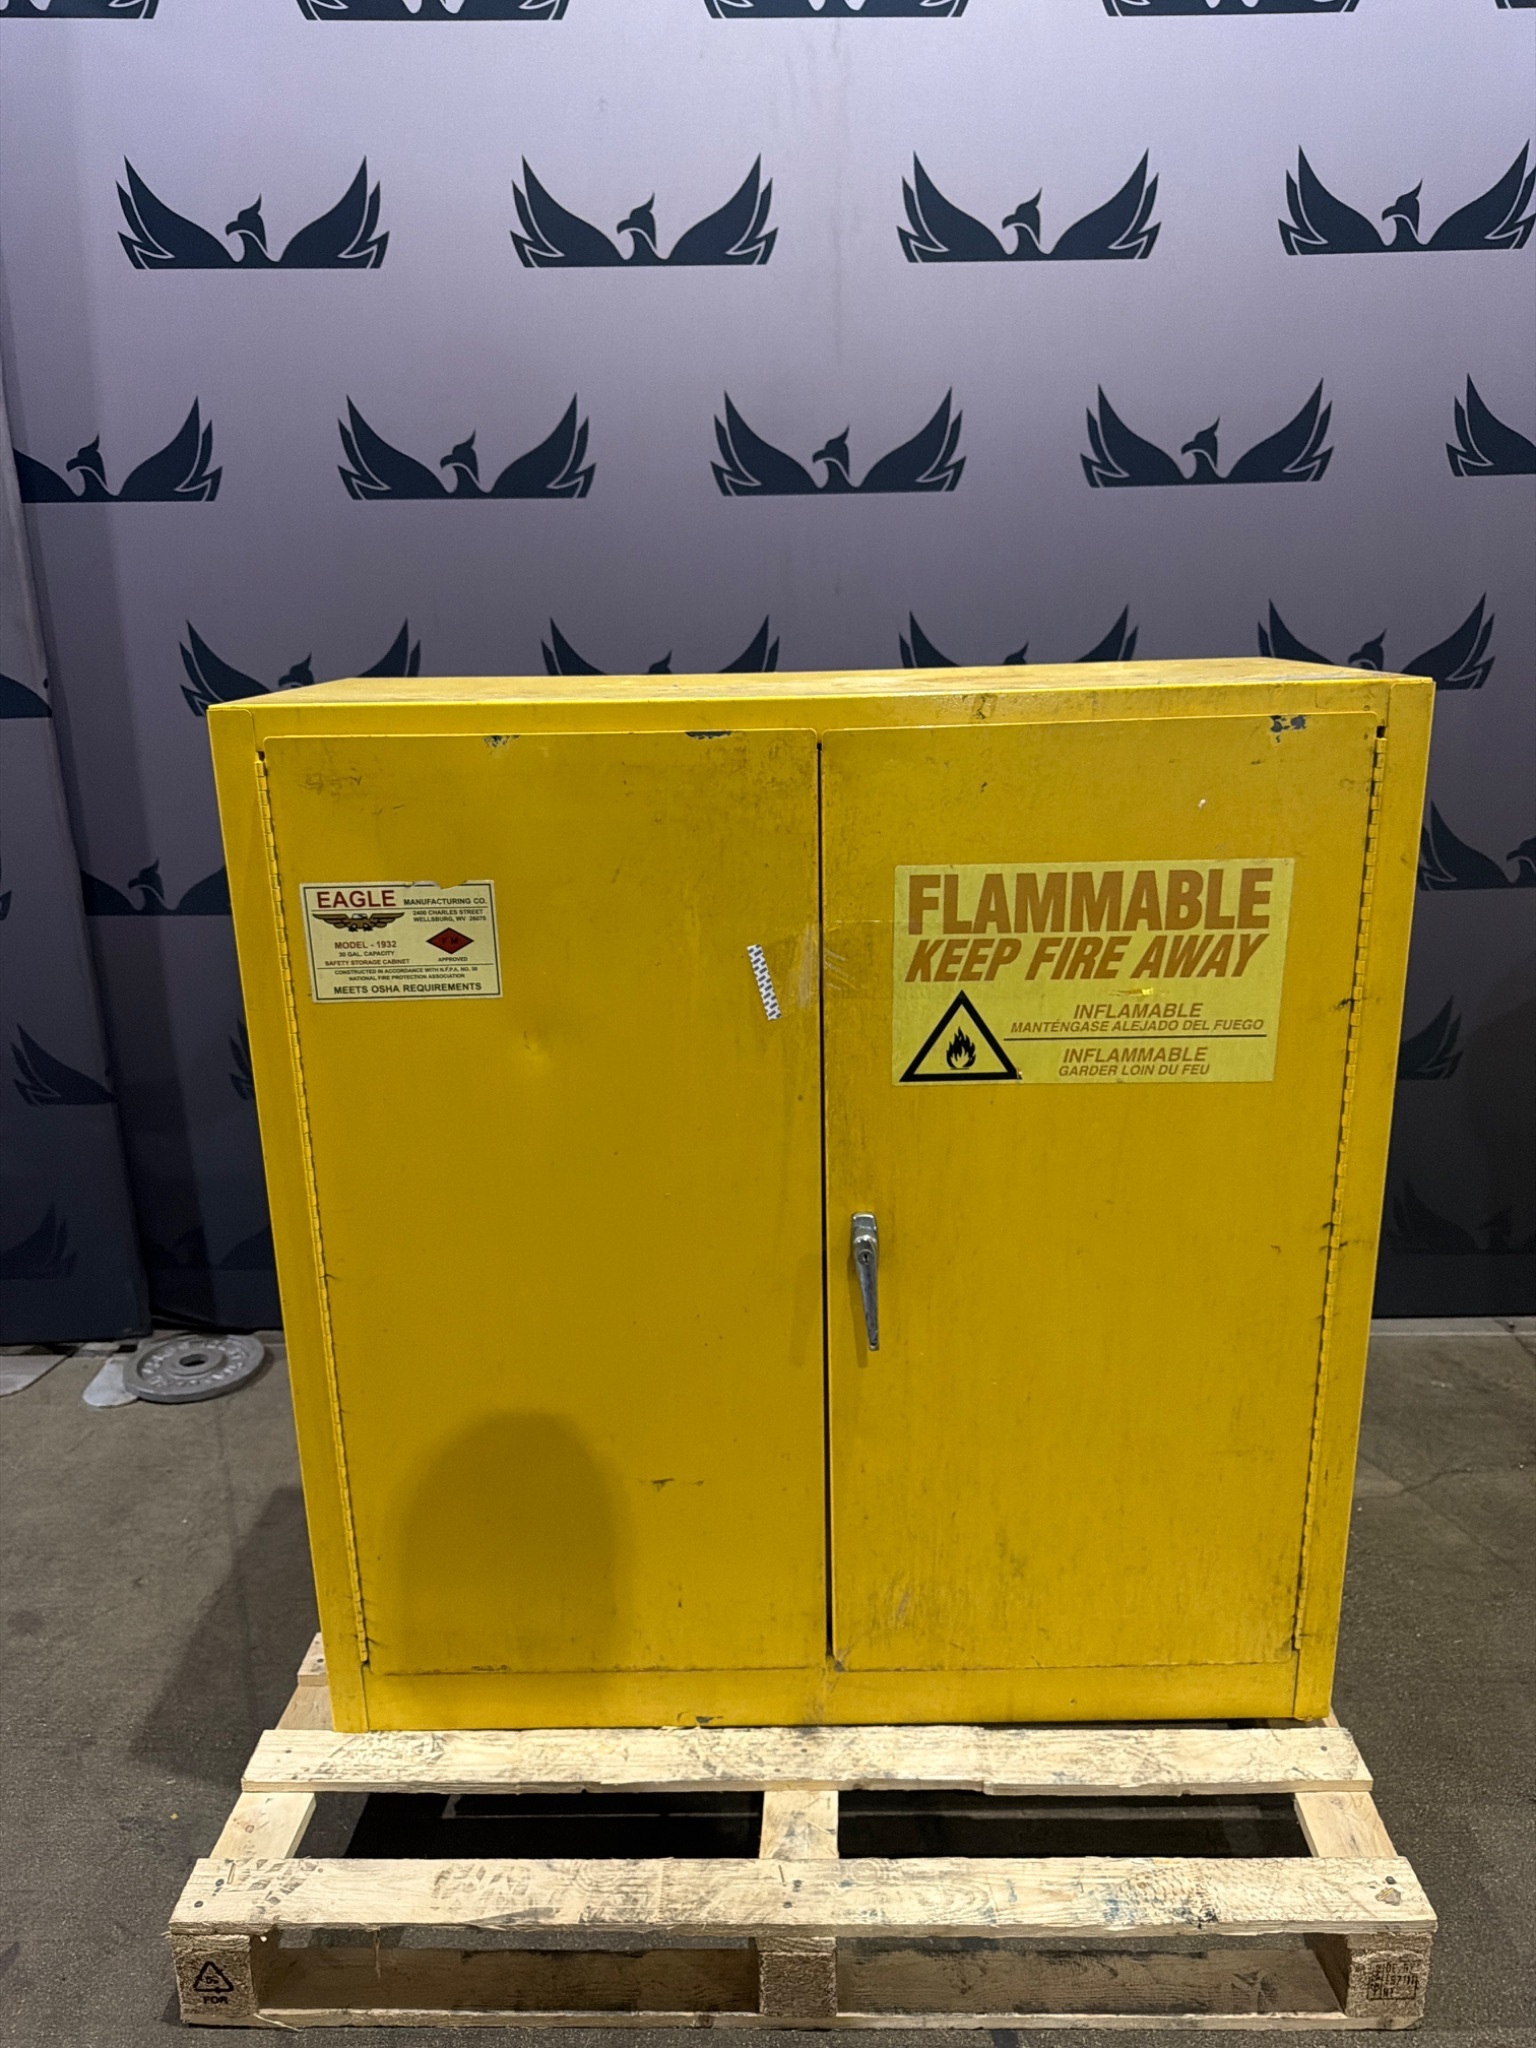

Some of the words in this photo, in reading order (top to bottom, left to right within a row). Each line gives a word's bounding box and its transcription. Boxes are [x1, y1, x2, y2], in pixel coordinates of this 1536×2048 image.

[317, 890, 396, 908] EAGLE
[908, 868, 1273, 935] FLAMMABLE
[905, 938, 1022, 982] KEEP
[1025, 936, 1132, 980] FIRE
[1129, 933, 1270, 979] AWAY
[334, 986, 368, 994] MEETS
[371, 985, 400, 993] OSHA
[403, 982, 482, 992] REQUIREMENTS
[1074, 1002, 1204, 1019] INFLAMABLE
[1010, 1018, 1110, 1033] MANTÉNGASE
[1111, 1020, 1180, 1032] ALEJADO
[1182, 1020, 1211, 1032] DEL
[1213, 1019, 1264, 1031] FUEGO
[1063, 1047, 1208, 1063] INFLAMMABLE
[1058, 1064, 1119, 1077] GARDER
[1121, 1064, 1157, 1076] LOIN
[1159, 1064, 1179, 1075] DU
[1181, 1064, 1210, 1075] FEU
